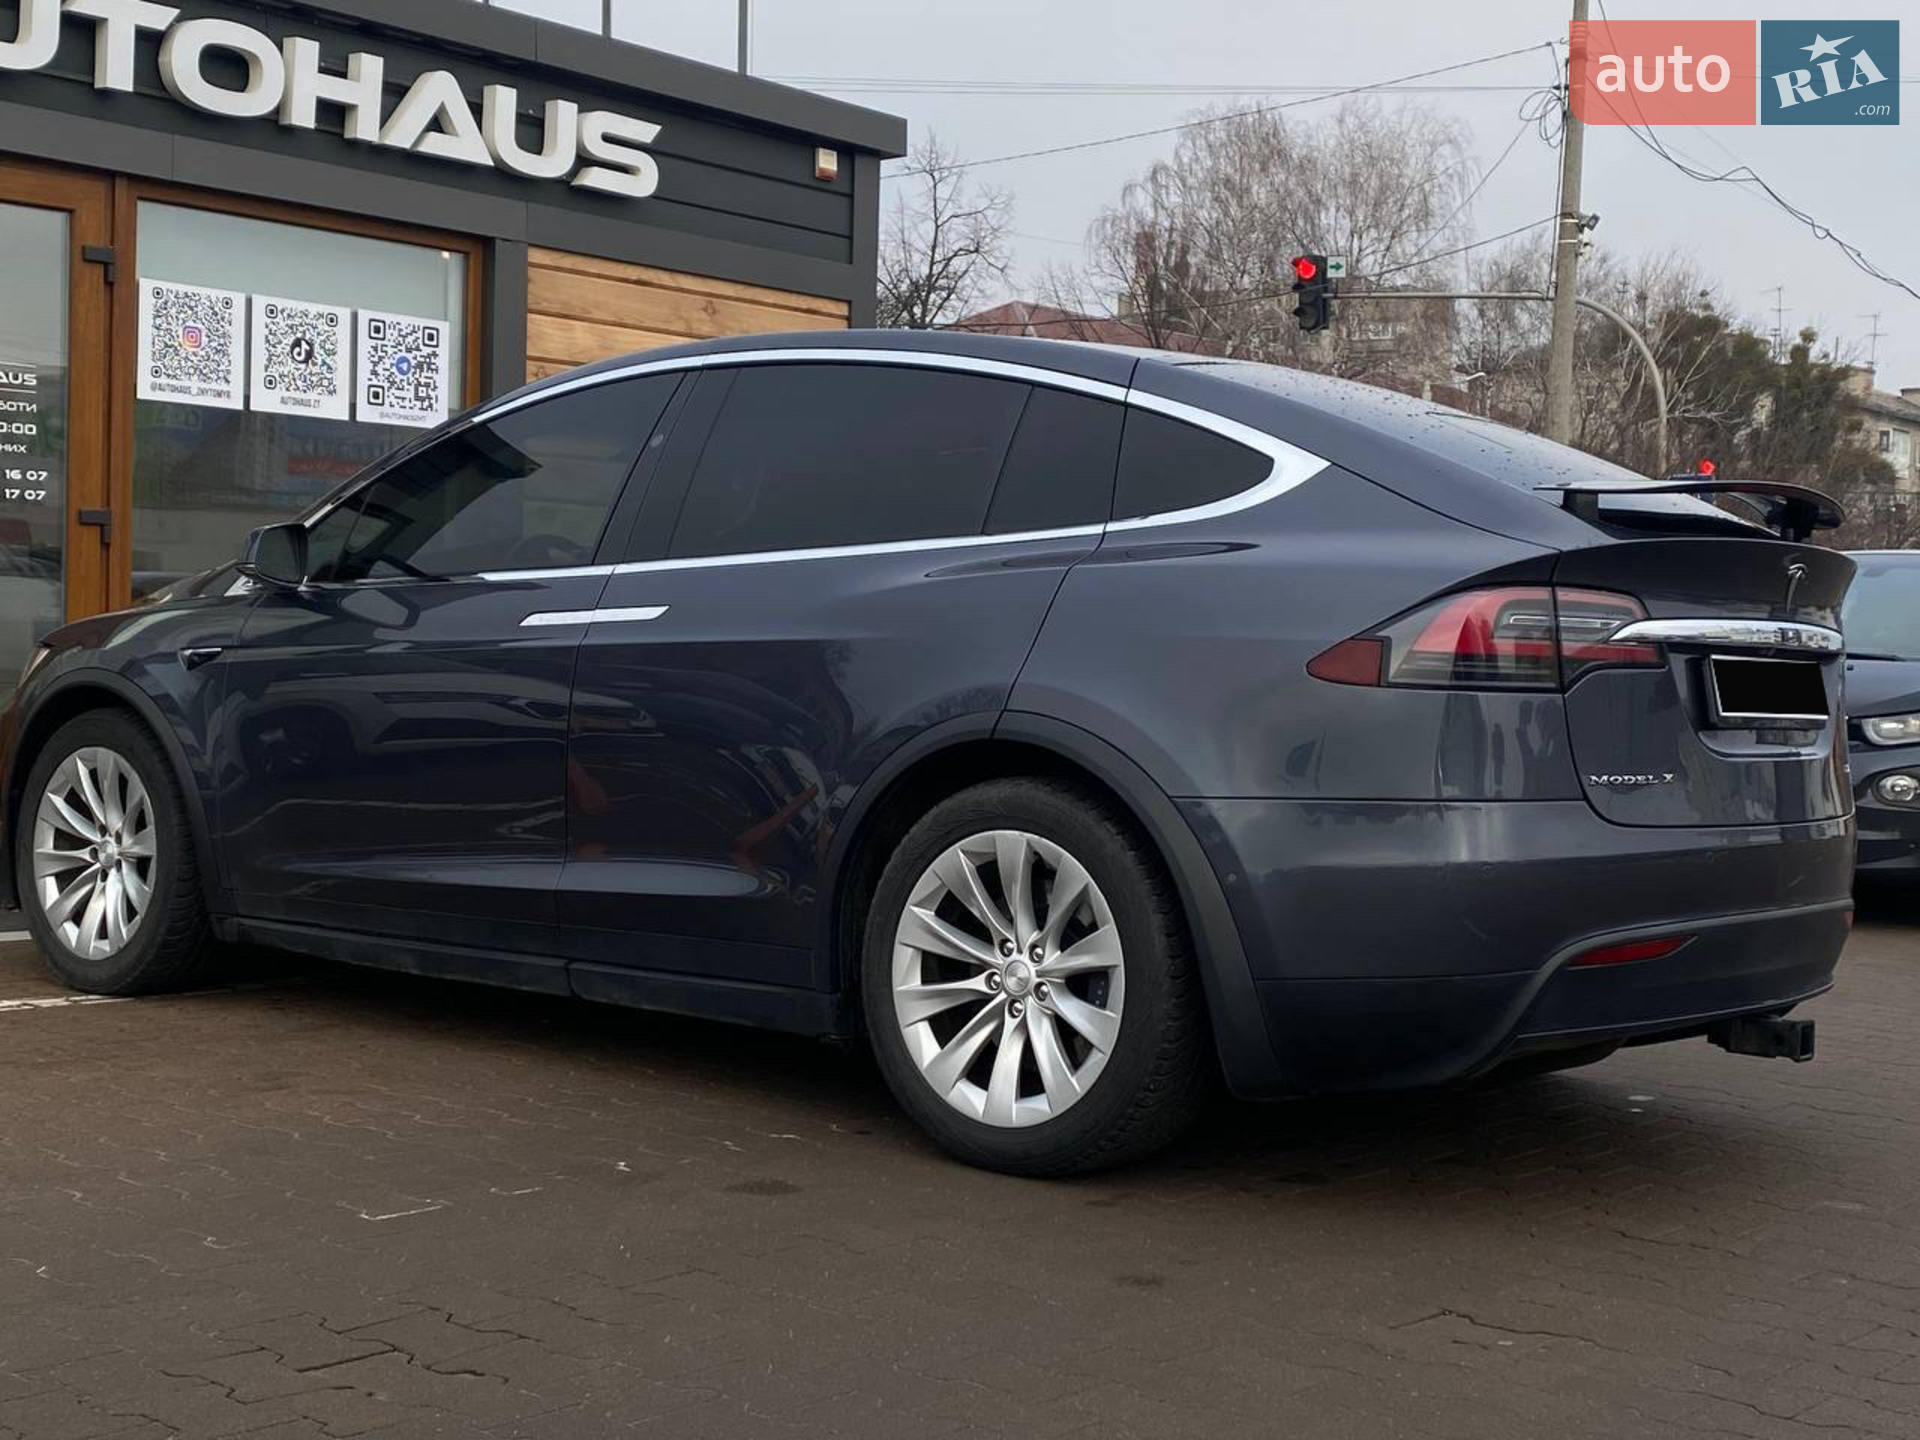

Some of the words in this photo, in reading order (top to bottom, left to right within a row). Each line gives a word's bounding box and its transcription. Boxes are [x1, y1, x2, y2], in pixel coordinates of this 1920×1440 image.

[5, 469, 22, 480] 16
[26, 470, 48, 481] 07
[4, 488, 21, 499] 17
[24, 489, 47, 501] 07
[1589, 774, 1659, 786] MODEL
[1662, 773, 1675, 783] X
